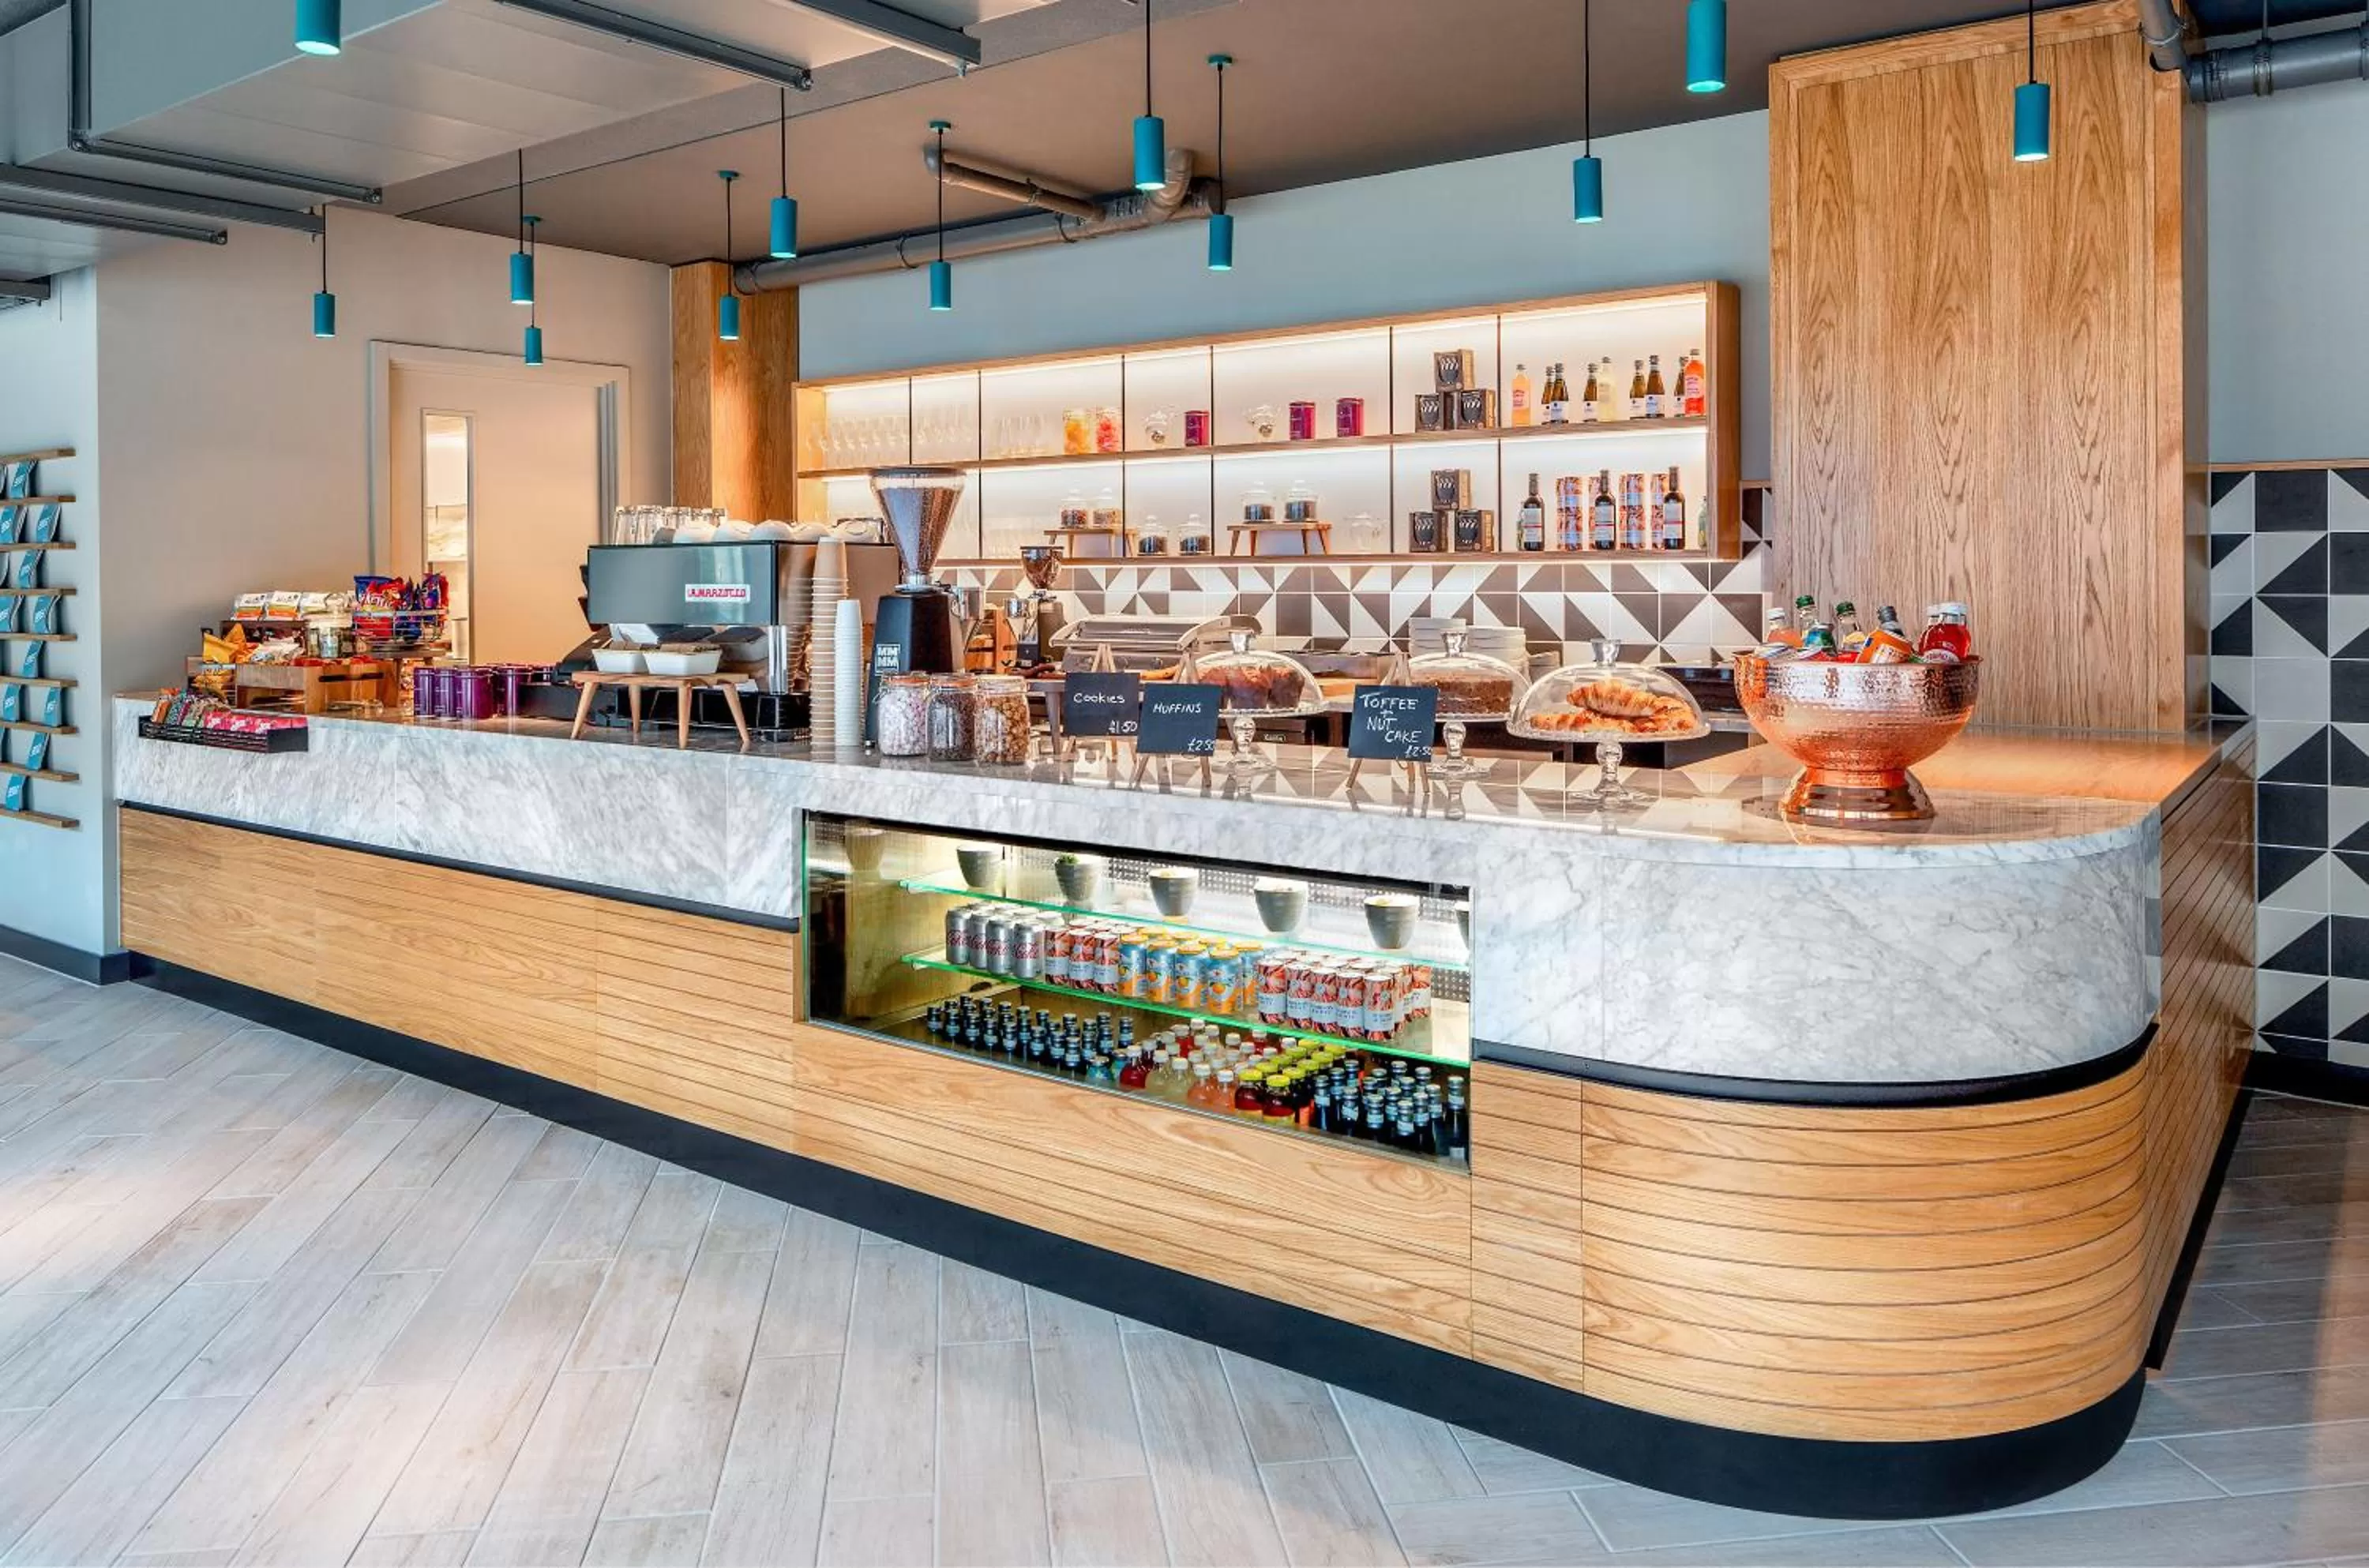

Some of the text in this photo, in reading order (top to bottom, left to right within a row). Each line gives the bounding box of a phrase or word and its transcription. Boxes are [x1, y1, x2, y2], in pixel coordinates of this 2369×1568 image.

[1073, 692, 1125, 704] Cookies
[1358, 692, 1418, 710] TOFFEE
[1152, 702, 1201, 715] MUFFINS
[1367, 715, 1398, 730] NUT
[1384, 730, 1421, 744] CAKE
